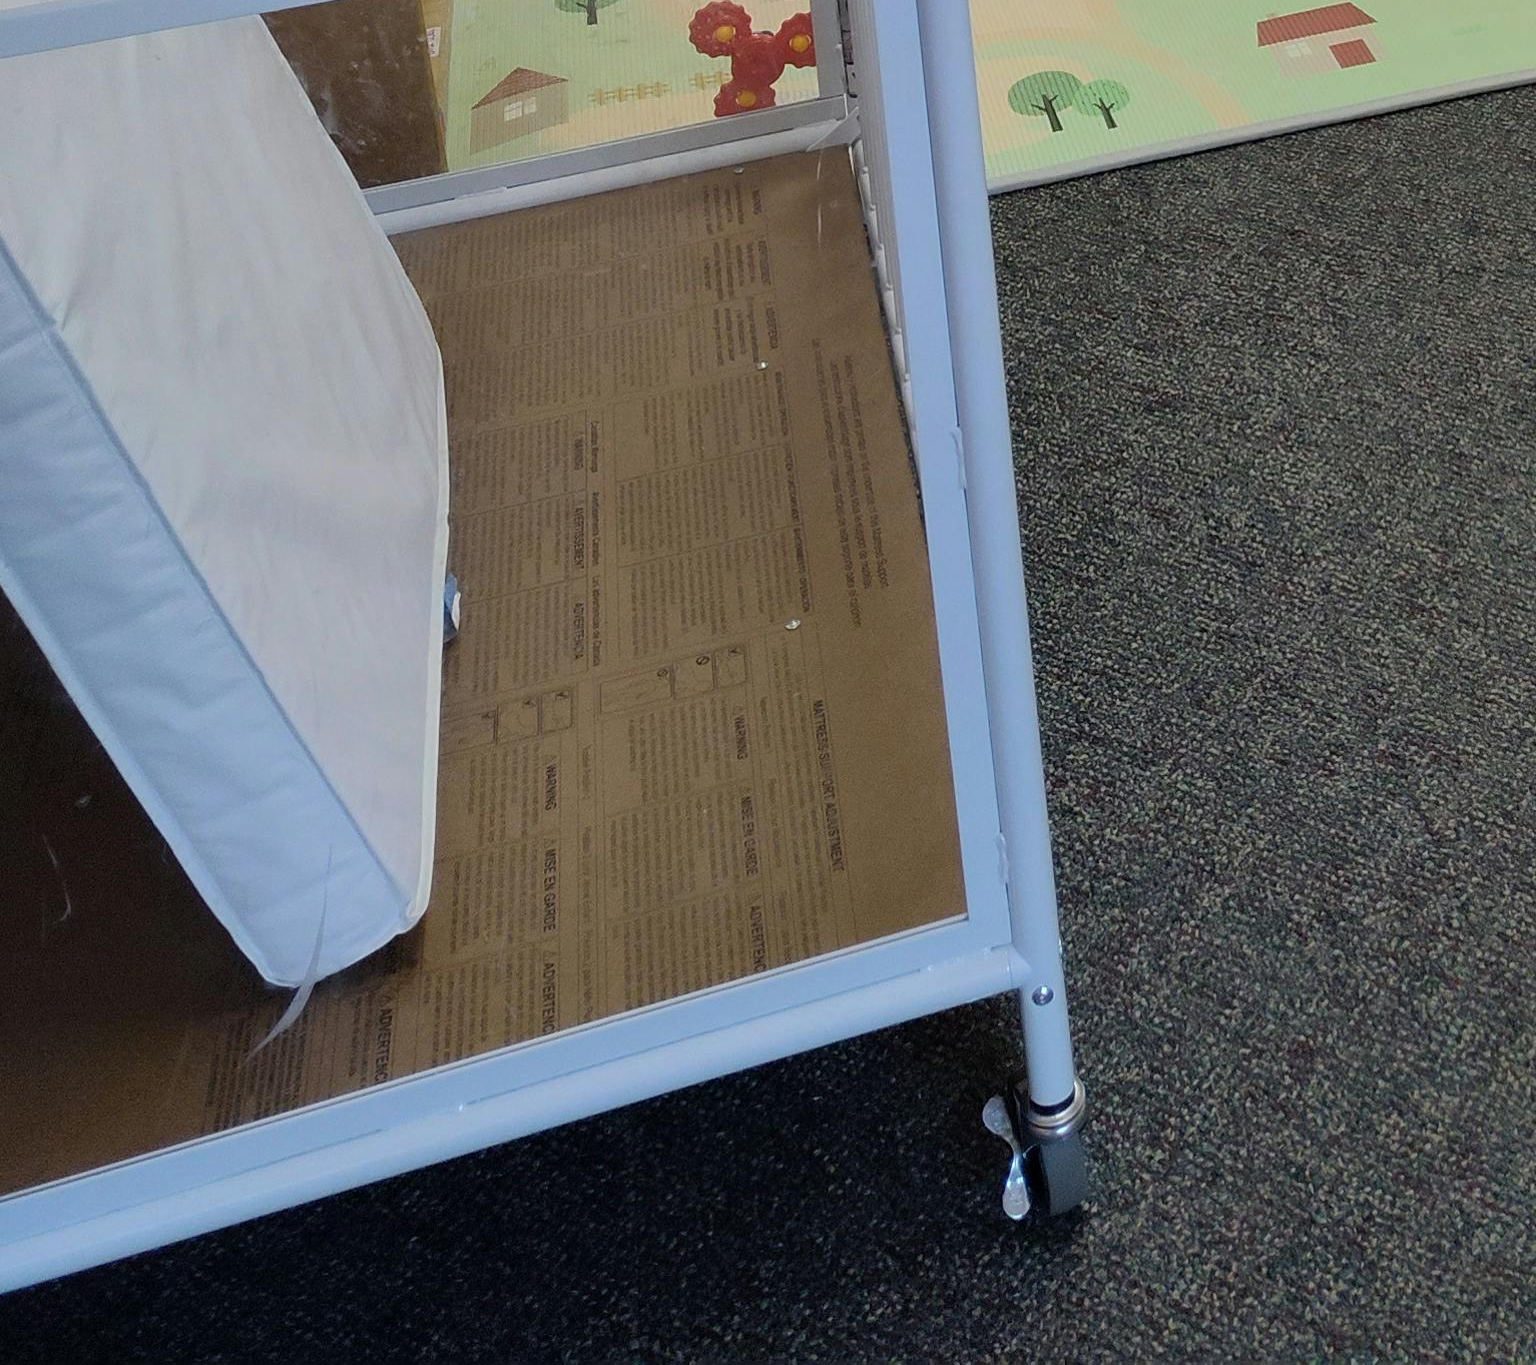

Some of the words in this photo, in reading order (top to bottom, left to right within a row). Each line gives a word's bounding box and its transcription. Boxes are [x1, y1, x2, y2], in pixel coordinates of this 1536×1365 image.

[734, 716, 748, 760] WARNING
[545, 765, 558, 812] WARNING
[812, 699, 828, 752] MATTRESS
[824, 802, 844, 871] ADJUSTMENT
[740, 796, 752, 820] MISE
[743, 823, 755, 838] EN
[543, 847, 557, 873] MISE
[744, 840, 759, 876] GARDE
[543, 876, 556, 891] EN
[542, 893, 556, 933] GARDE
